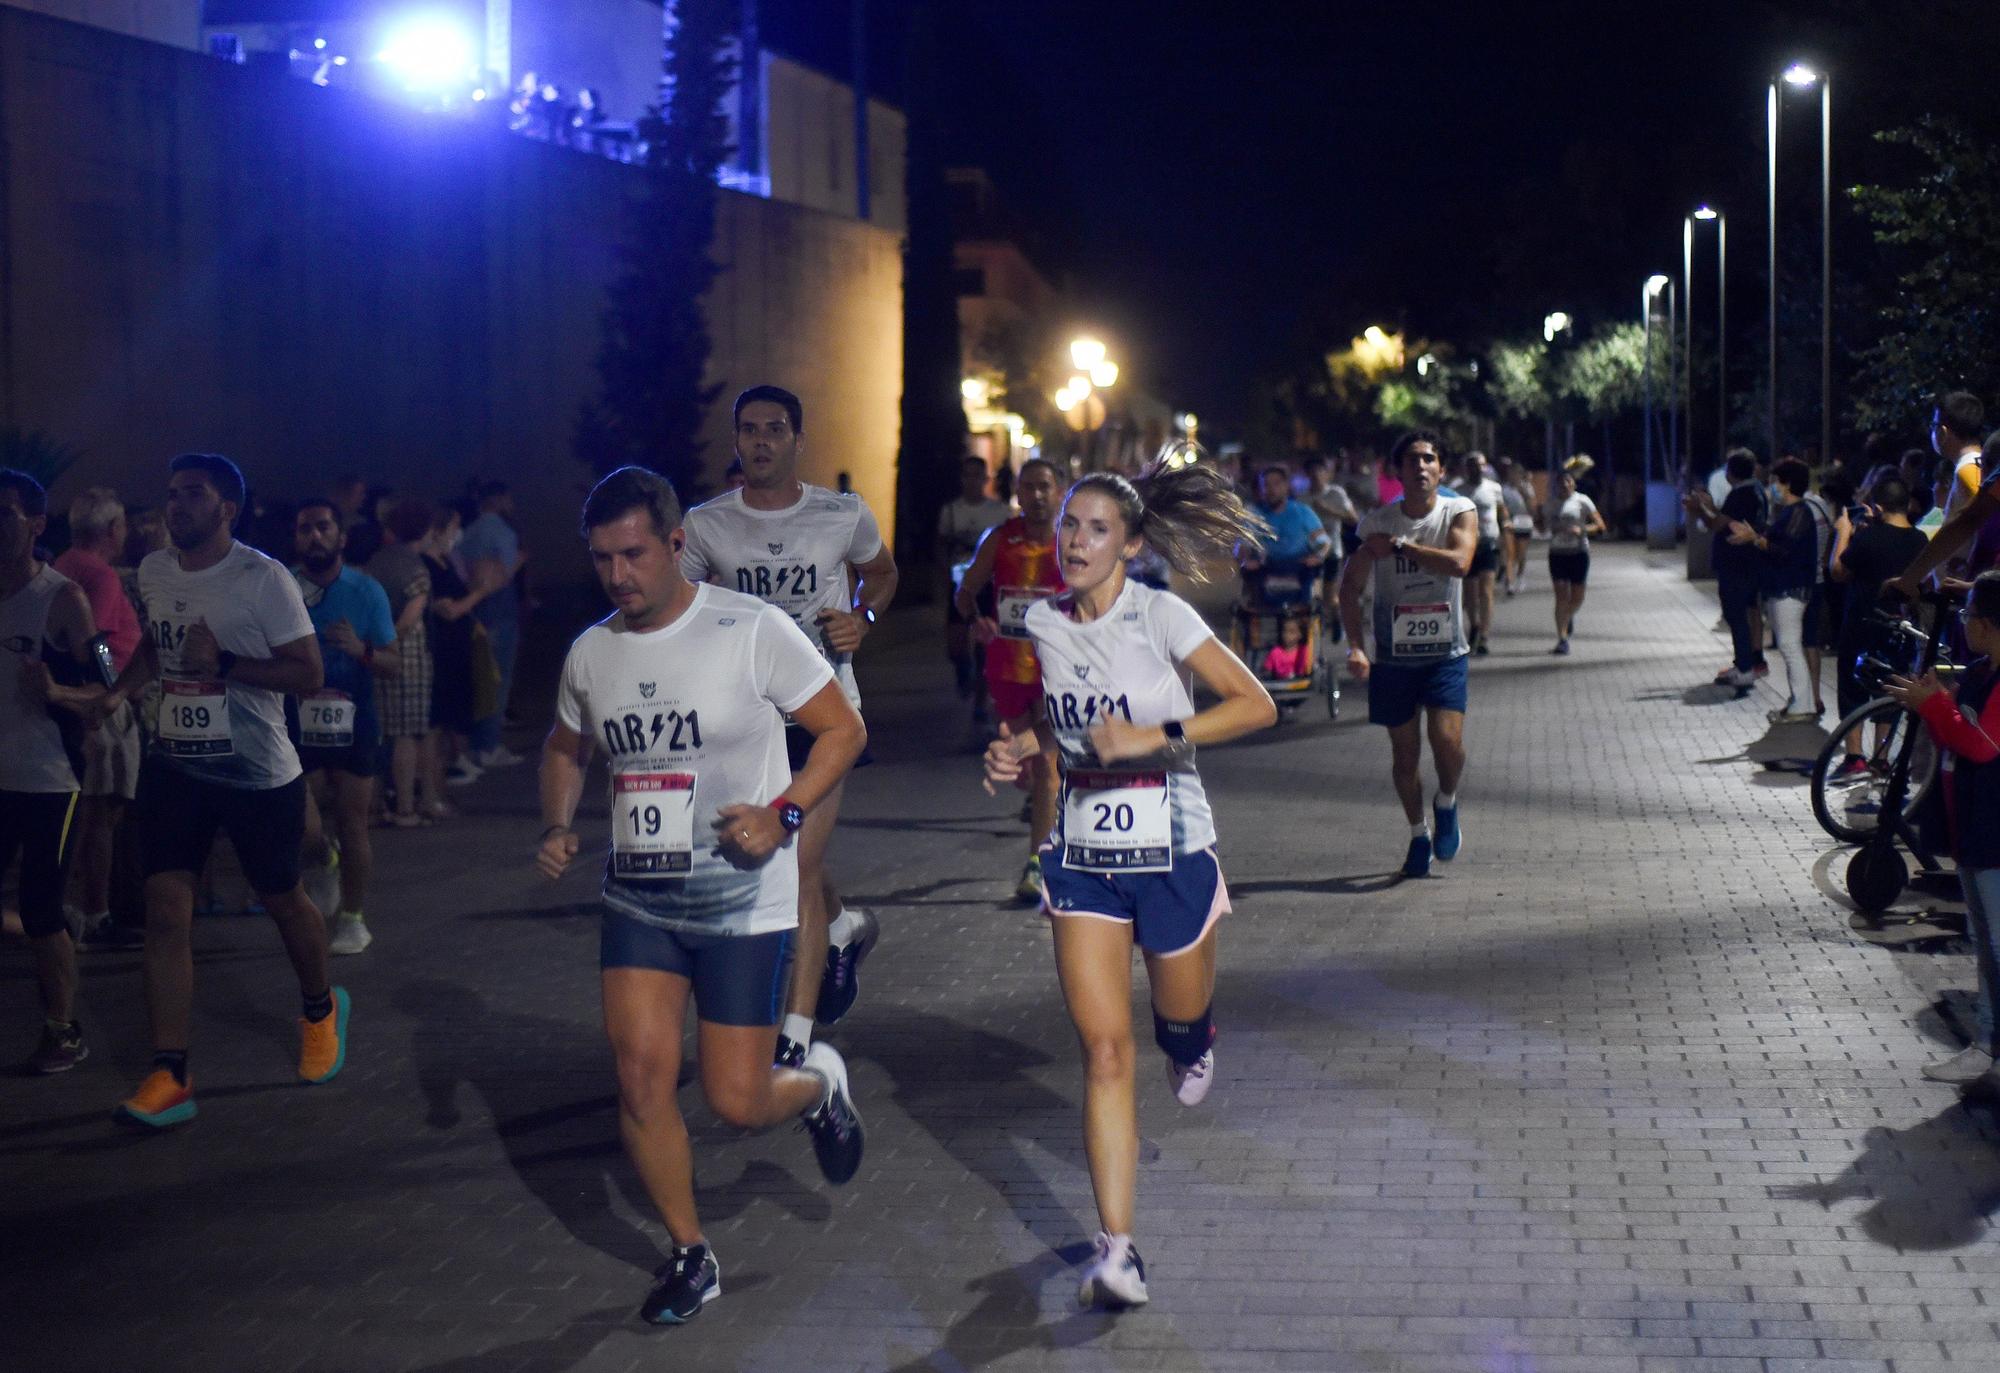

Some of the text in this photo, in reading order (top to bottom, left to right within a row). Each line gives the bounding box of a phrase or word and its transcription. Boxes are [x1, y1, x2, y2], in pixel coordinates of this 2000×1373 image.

[1407, 620, 1439, 637] 299
[171, 703, 211, 729] 189
[310, 707, 344, 725] 768
[667, 709, 703, 751] 21
[629, 805, 663, 837] 19
[1092, 802, 1135, 832] 20
